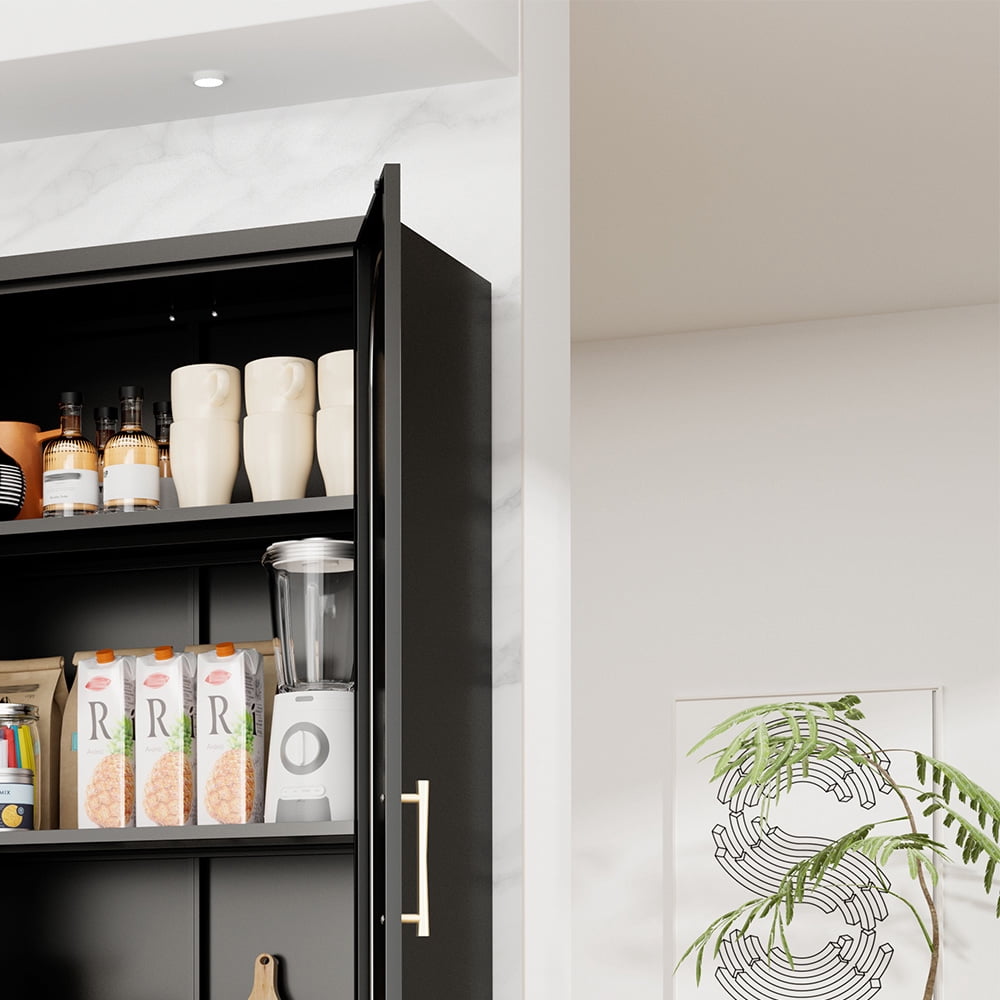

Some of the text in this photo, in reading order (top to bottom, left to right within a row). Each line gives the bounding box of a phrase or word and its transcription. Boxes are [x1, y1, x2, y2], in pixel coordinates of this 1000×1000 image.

[88, 701, 112, 740] R
[147, 698, 170, 738] R
[208, 695, 232, 735] R
